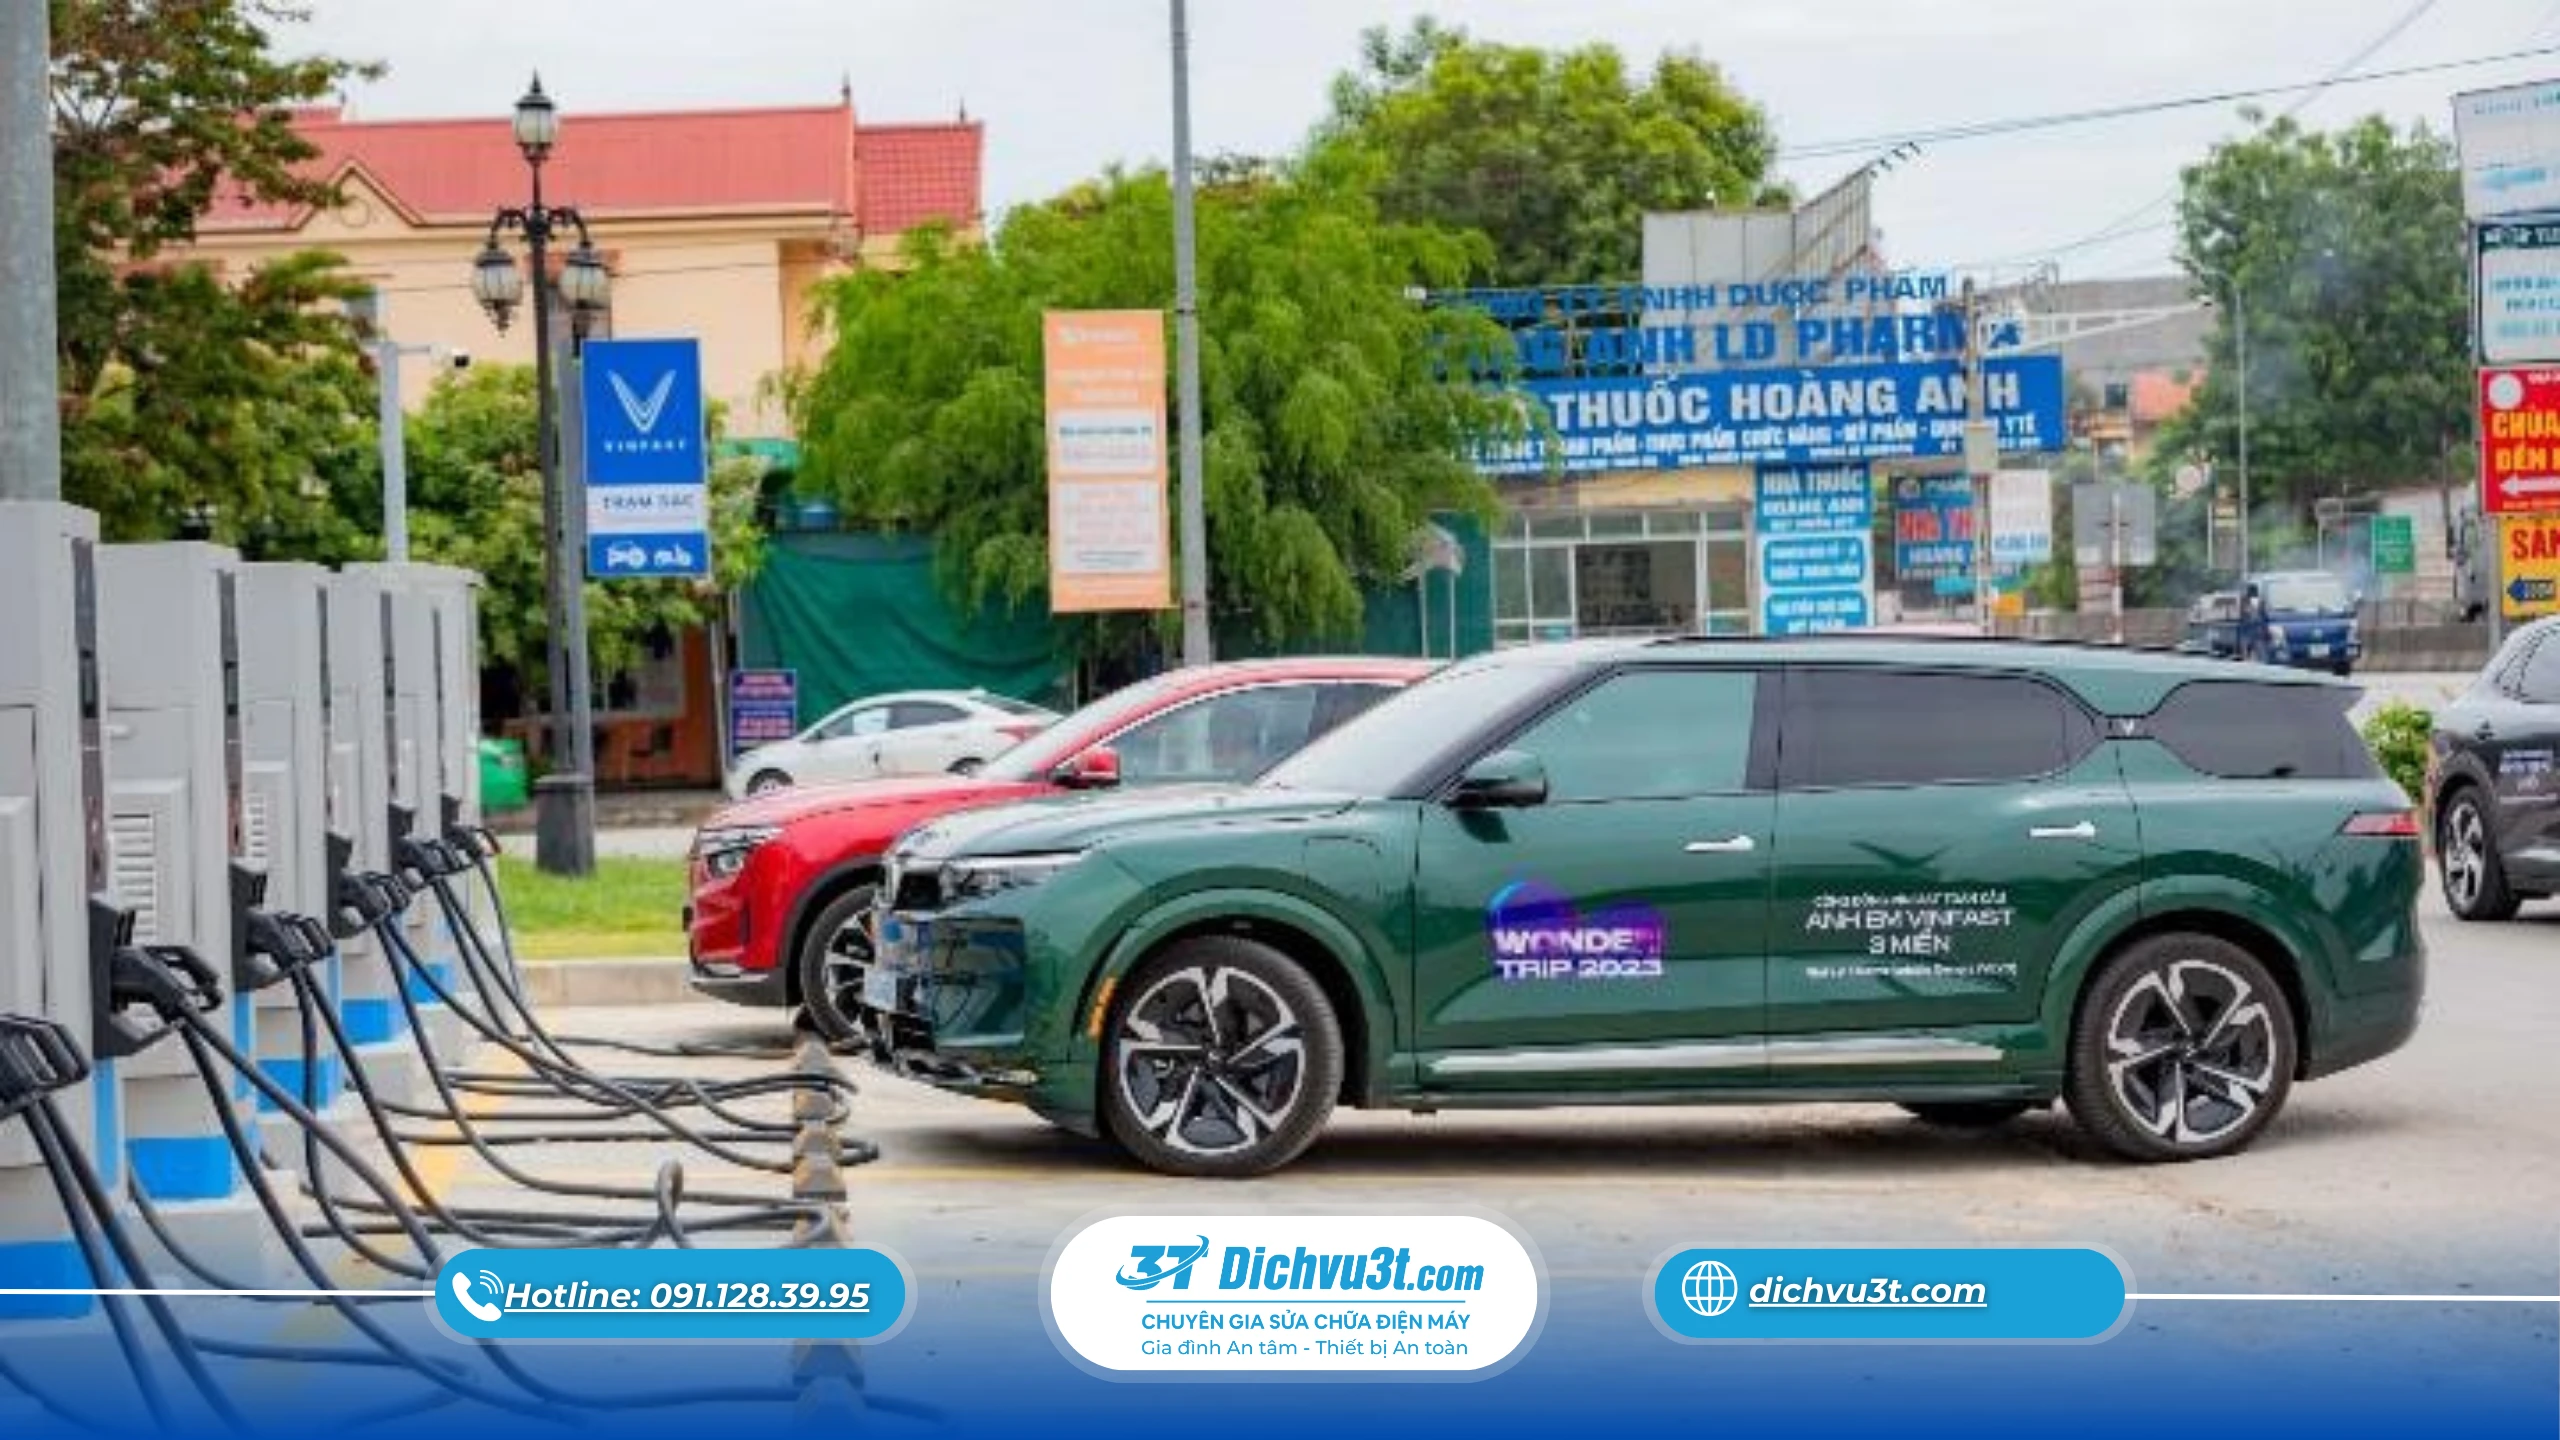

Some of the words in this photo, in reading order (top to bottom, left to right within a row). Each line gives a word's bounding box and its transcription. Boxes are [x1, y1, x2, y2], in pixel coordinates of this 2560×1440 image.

[1714, 319, 1775, 363] LD
[1547, 372, 1712, 431] THUỐC
[1729, 369, 1899, 422] HOÀNG
[1915, 371, 2020, 414] ANH
[1806, 910, 1860, 930] ANH
[1866, 910, 1901, 929] EM
[1906, 908, 2014, 928] VINFAST
[1869, 934, 1886, 955] 3
[1495, 957, 1574, 980] TRIP
[1578, 959, 1664, 977] 2023
